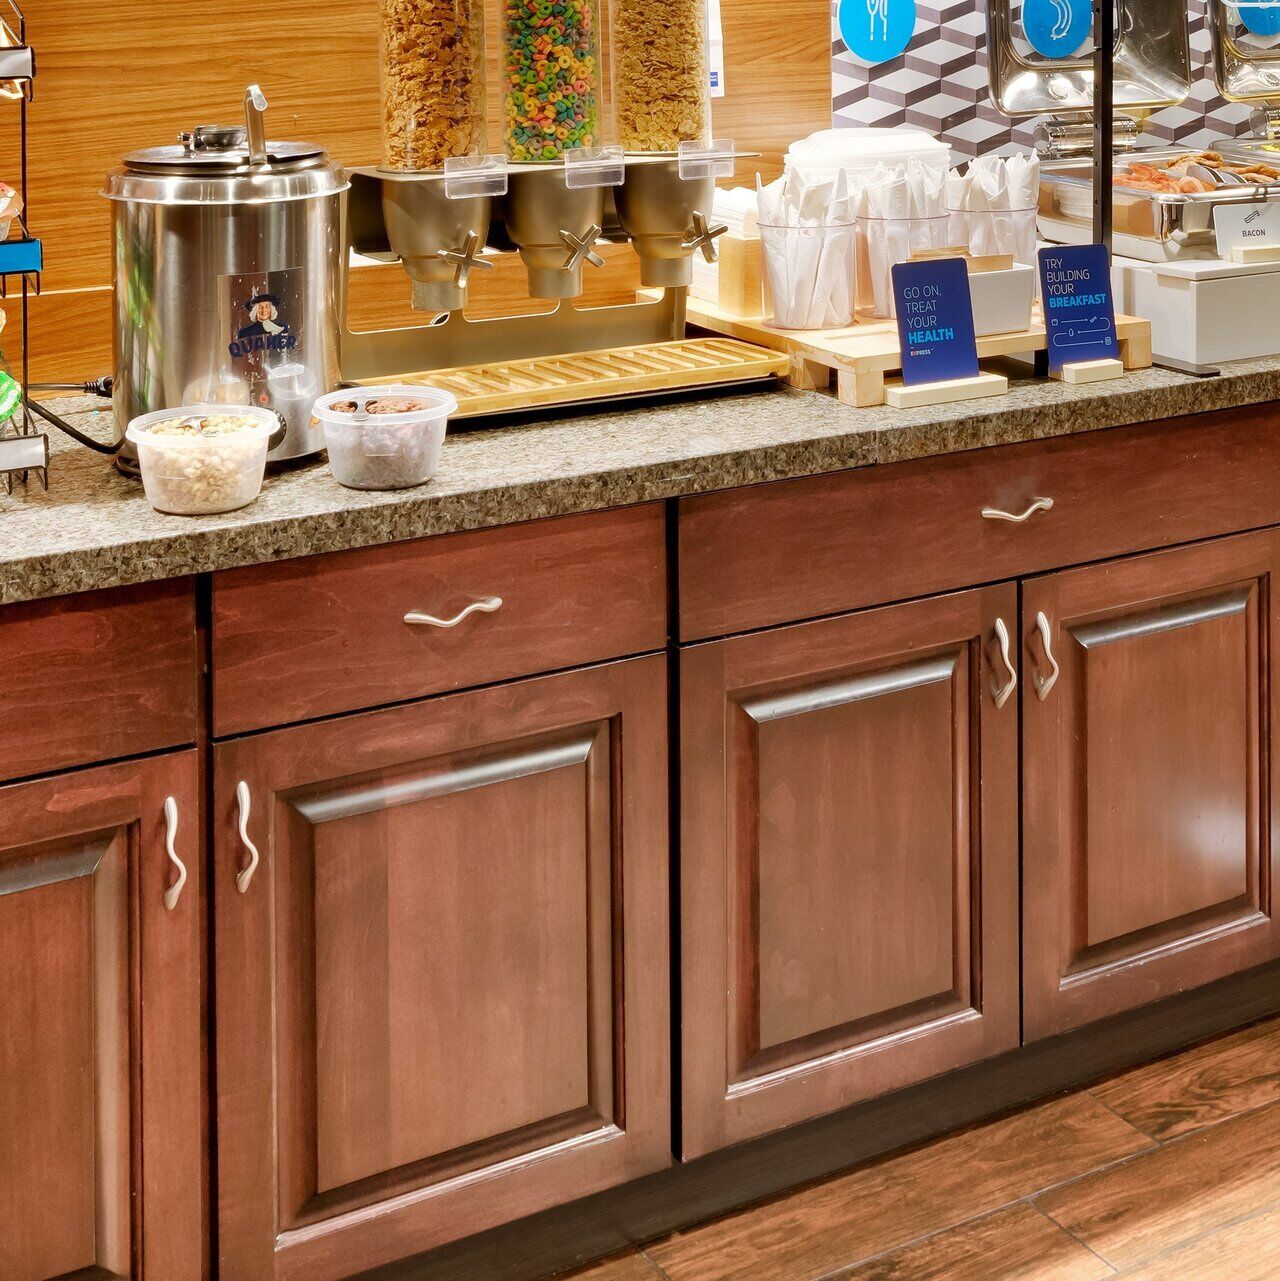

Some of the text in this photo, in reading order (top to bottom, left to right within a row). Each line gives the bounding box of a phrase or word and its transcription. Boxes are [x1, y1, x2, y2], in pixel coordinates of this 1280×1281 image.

[1242, 228, 1266, 238] BACON
[1045, 258, 1063, 270] TRY
[1046, 269, 1090, 283] BUILDING
[903, 284, 942, 299] GO ON,
[1047, 283, 1074, 296] YOUR
[905, 299, 937, 314] TREAT
[1049, 293, 1107, 309] BREAKFAST
[906, 314, 938, 329] YOUR
[908, 327, 954, 345] HEALTH
